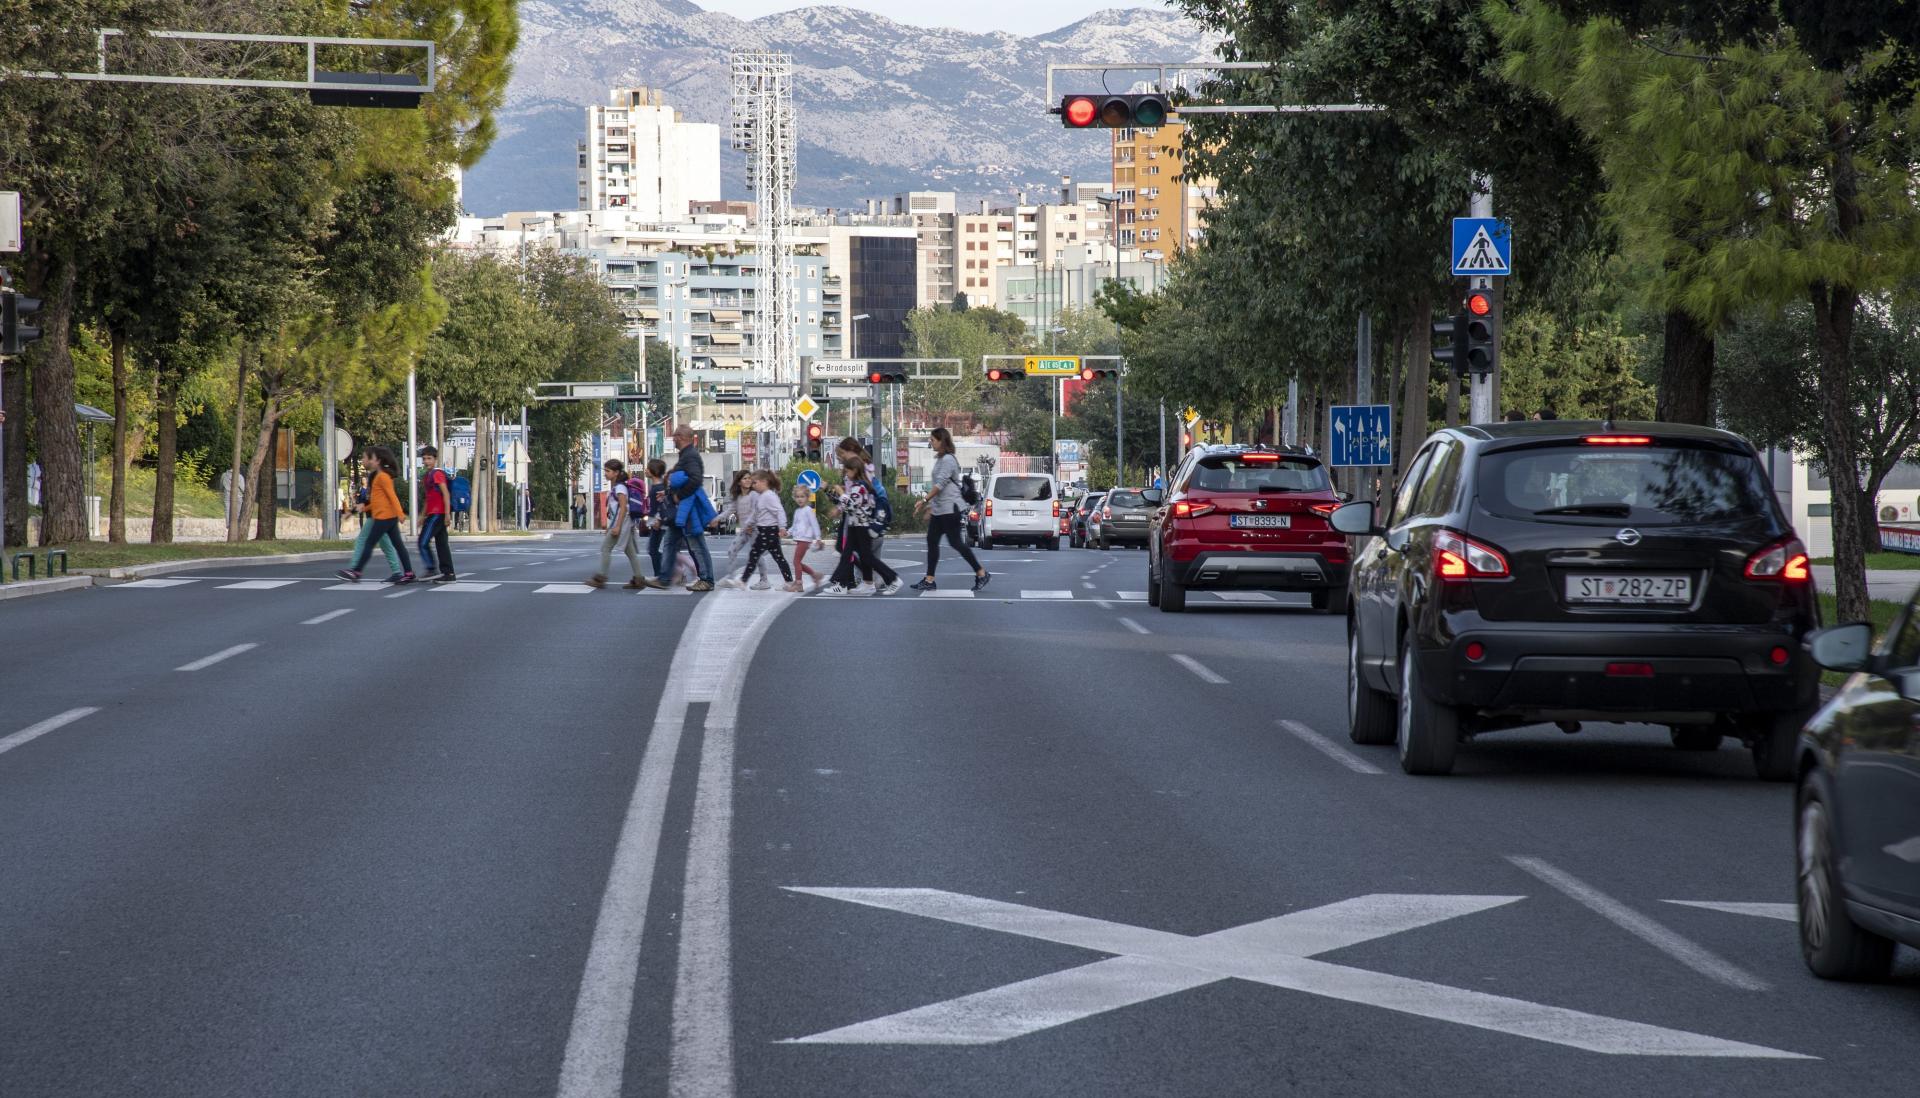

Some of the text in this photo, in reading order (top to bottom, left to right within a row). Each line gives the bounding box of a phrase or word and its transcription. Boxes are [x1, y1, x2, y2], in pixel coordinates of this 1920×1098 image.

[826, 363, 864, 373] Brodosplit
[1237, 516, 1287, 526] ST 8393-N
[1581, 578, 1686, 597] ST 282-ZP
